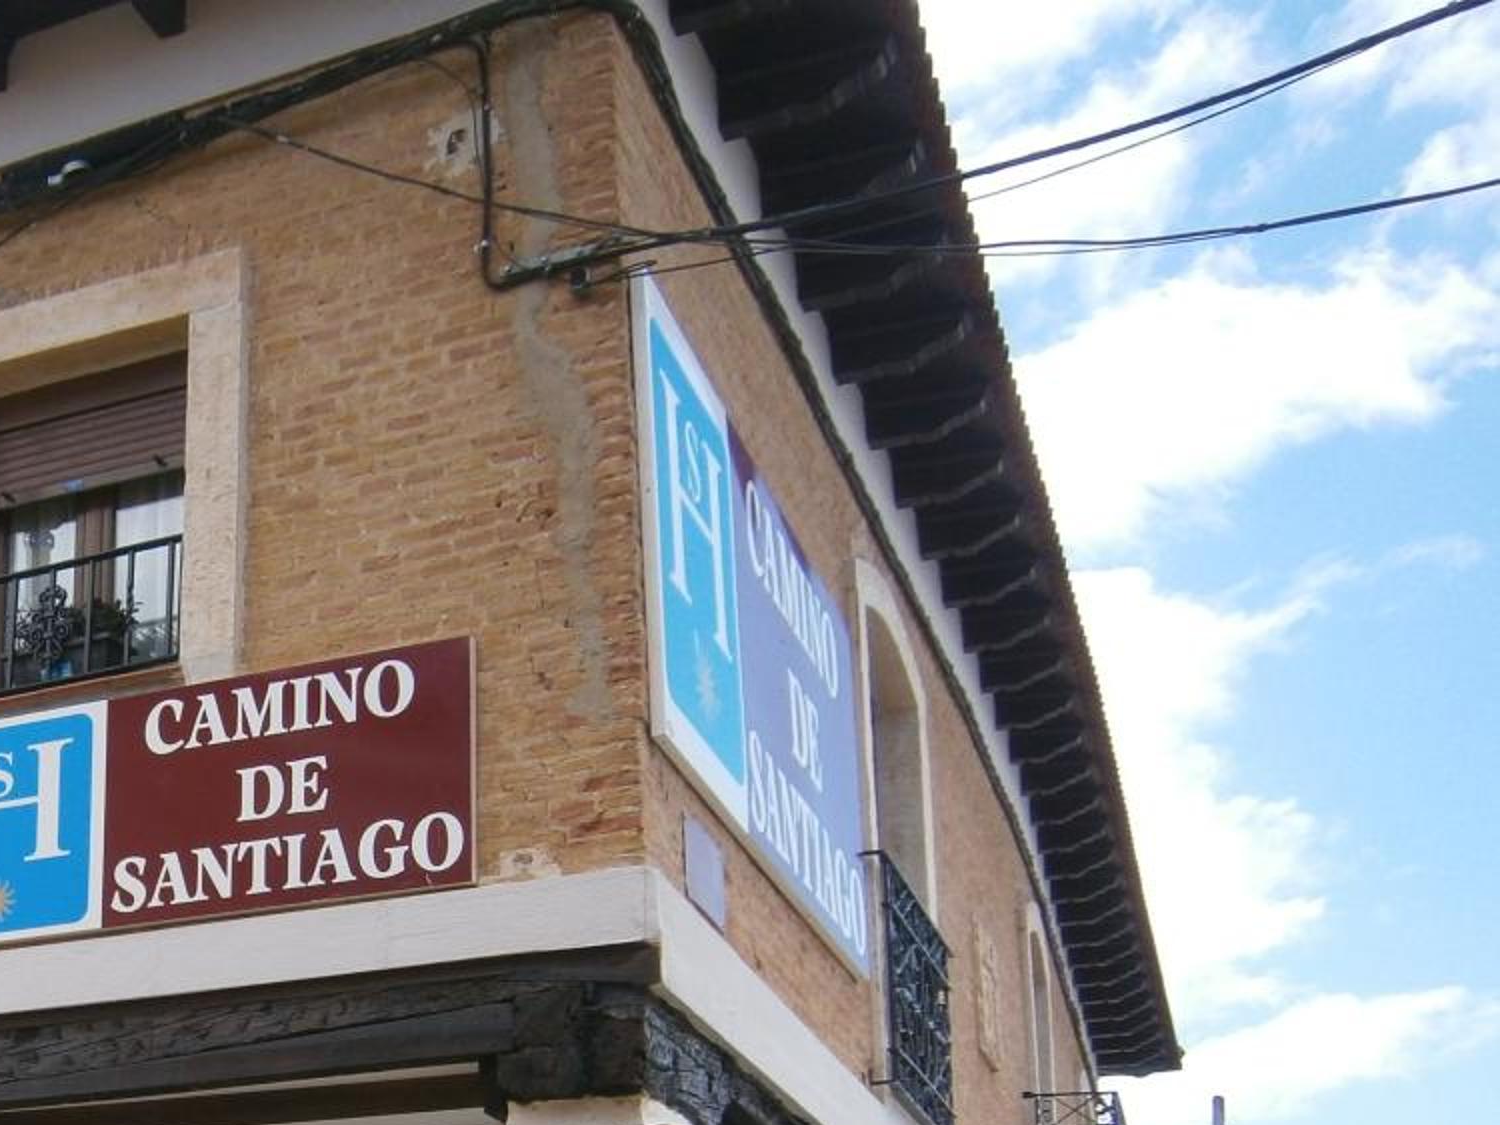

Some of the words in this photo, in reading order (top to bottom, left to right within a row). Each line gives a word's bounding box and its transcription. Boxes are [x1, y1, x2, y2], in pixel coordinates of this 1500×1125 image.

[745, 478, 838, 699] CAMINO
[145, 659, 415, 756] CAMINO
[787, 667, 823, 791] DE
[235, 755, 329, 823] DE
[748, 729, 867, 957] SANTIAGO
[111, 812, 464, 914] SANTIAGO
